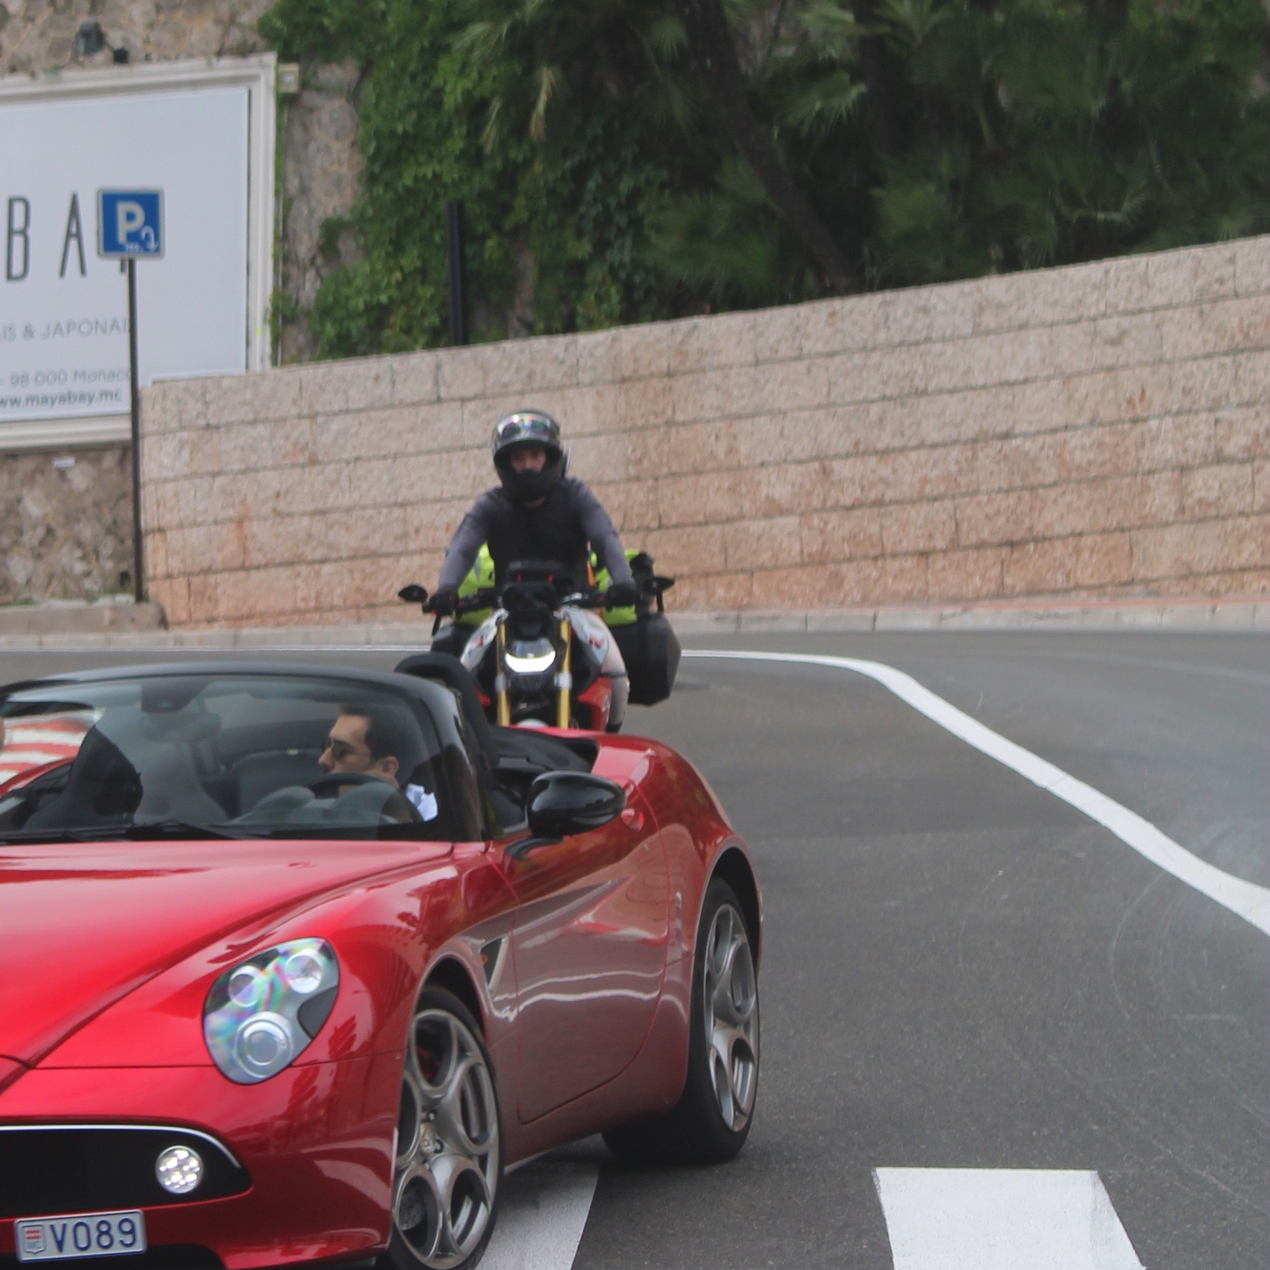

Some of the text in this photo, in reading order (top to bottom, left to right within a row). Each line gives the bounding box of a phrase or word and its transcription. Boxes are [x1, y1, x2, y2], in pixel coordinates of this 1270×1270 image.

[117, 201, 145, 244] P
[23, 322, 35, 341] &
[40, 317, 129, 340] JAPONAI
[34, 368, 69, 387] 000
[50, 1217, 137, 1253] V089
